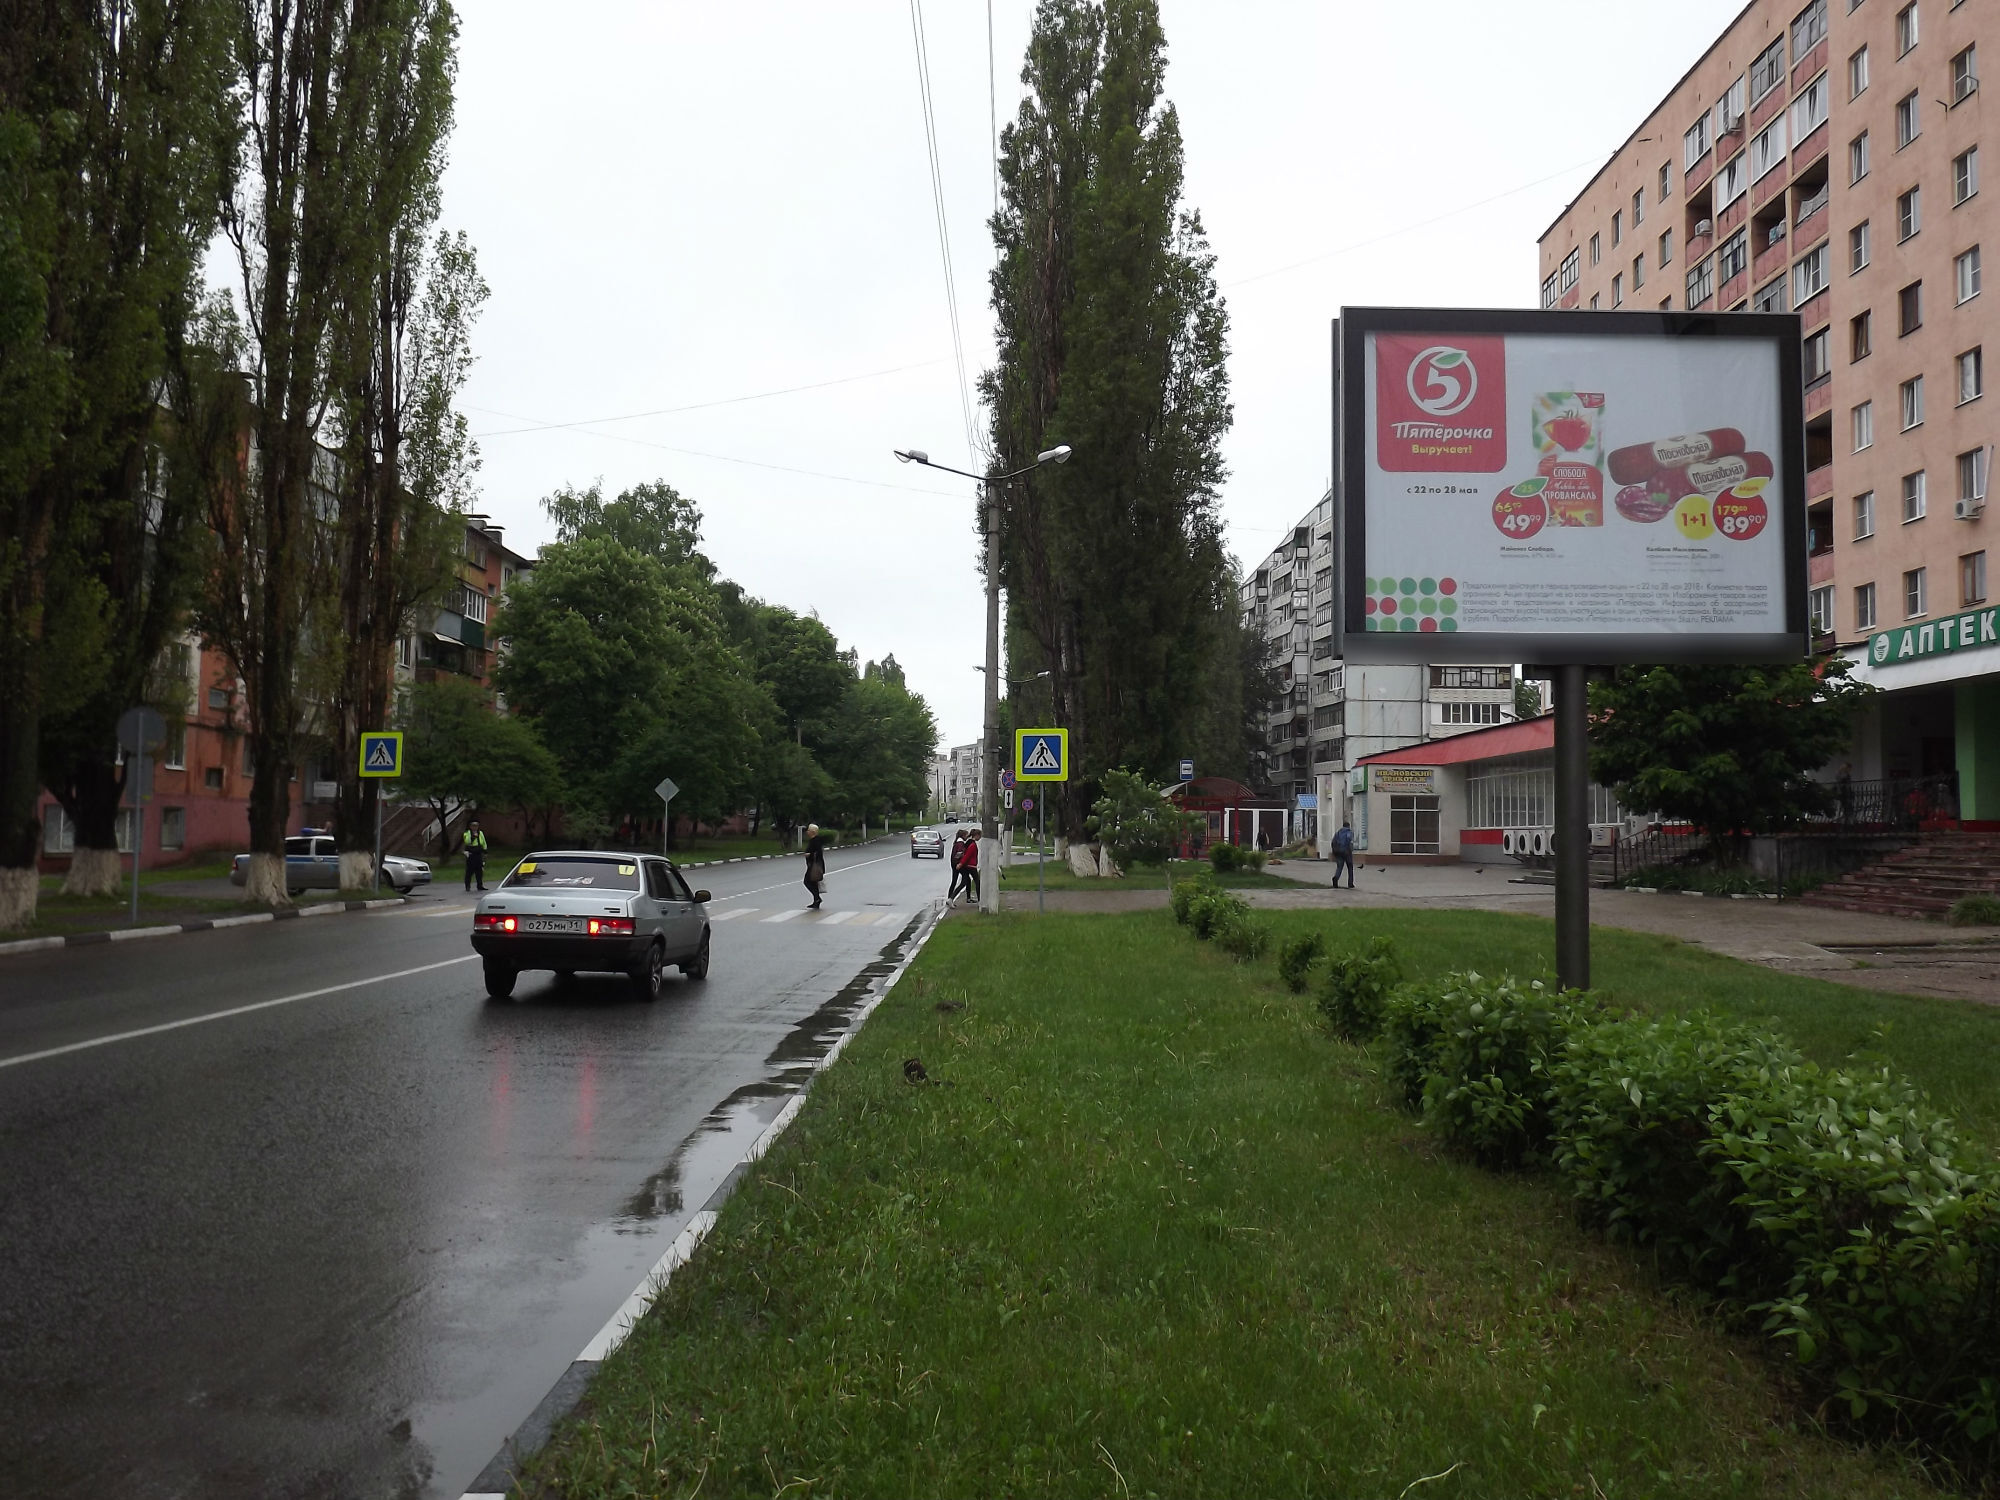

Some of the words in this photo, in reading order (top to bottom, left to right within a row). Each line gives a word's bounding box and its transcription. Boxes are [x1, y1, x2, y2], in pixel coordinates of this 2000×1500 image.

[1422, 366, 1461, 410] 5
[1391, 422, 1493, 442] Пятёрочка
[1412, 445, 1473, 456] Выручает!
[1657, 443, 1711, 462] Московская
[1692, 464, 1745, 485] Московская
[1414, 486, 1426, 494] 22
[1445, 486, 1457, 494] 28
[1545, 491, 1597, 500] ПРОВАНСАЛЬ
[1682, 512, 1707, 527] 1+1
